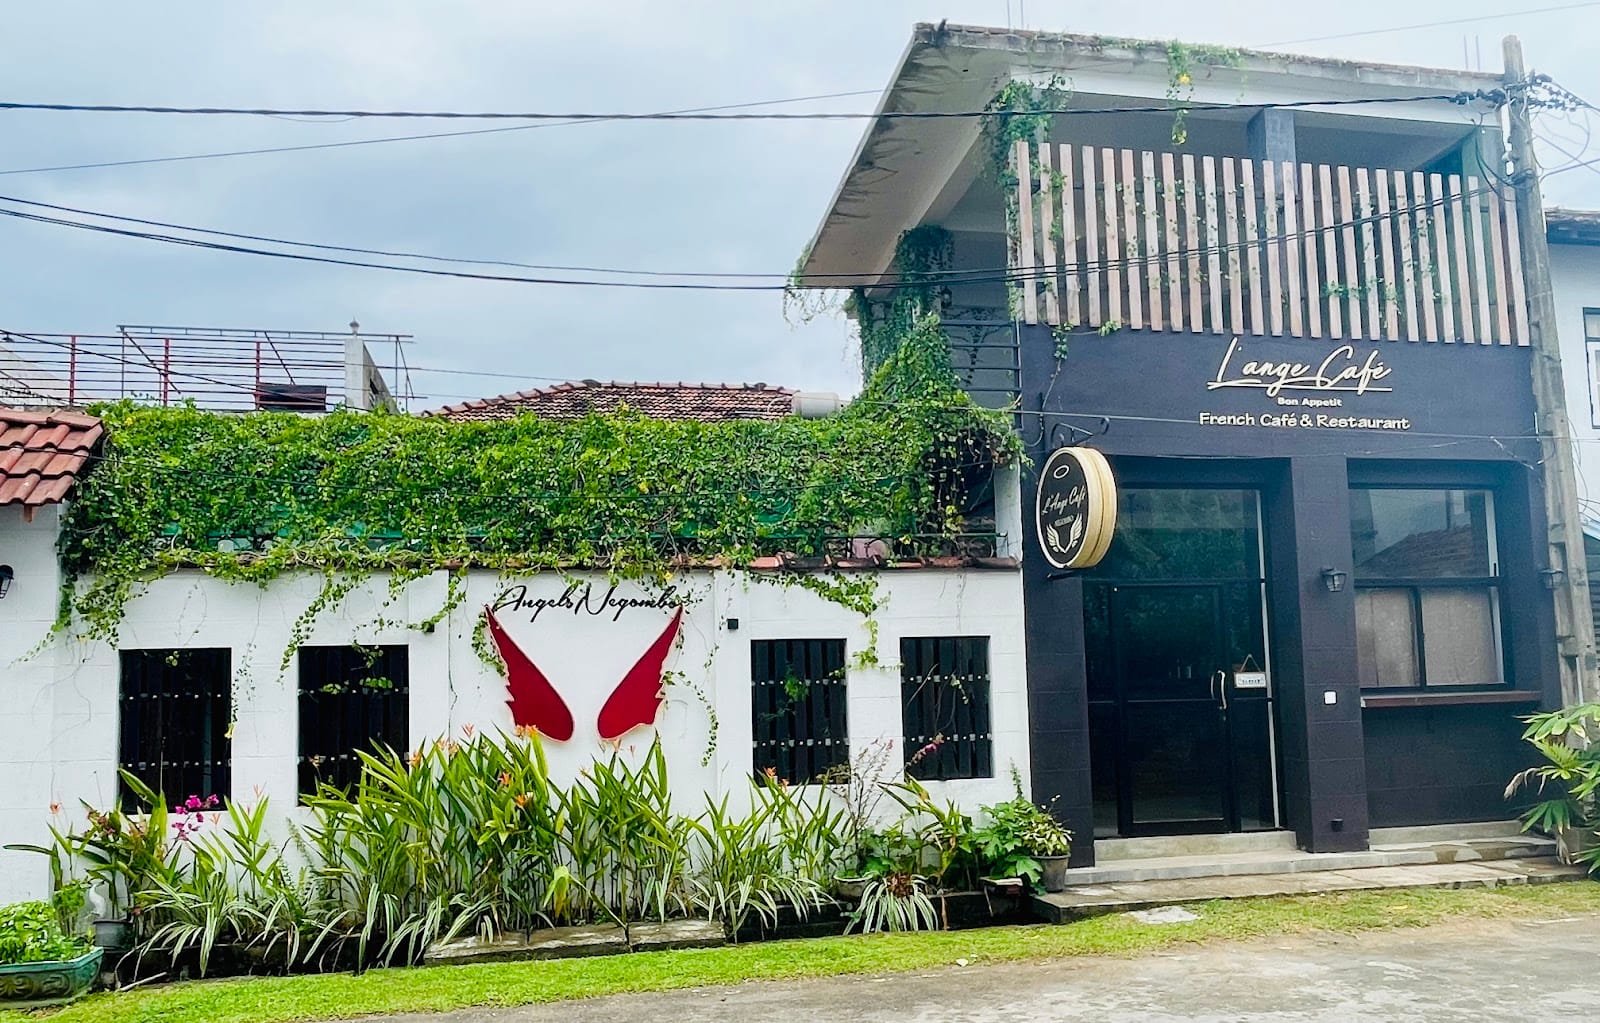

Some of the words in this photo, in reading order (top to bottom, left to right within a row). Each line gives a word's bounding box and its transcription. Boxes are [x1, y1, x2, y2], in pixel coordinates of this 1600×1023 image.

[1315, 345, 1392, 395] Café
[1277, 397, 1299, 406] Bon
[1302, 398, 1342, 407] Appetit
[1199, 412, 1255, 426] French
[1260, 412, 1297, 427] Café
[1299, 415, 1313, 427] &
[1316, 415, 1410, 429] Restaurant
[493, 585, 574, 623] Angels
[574, 584, 681, 622] Negombo
